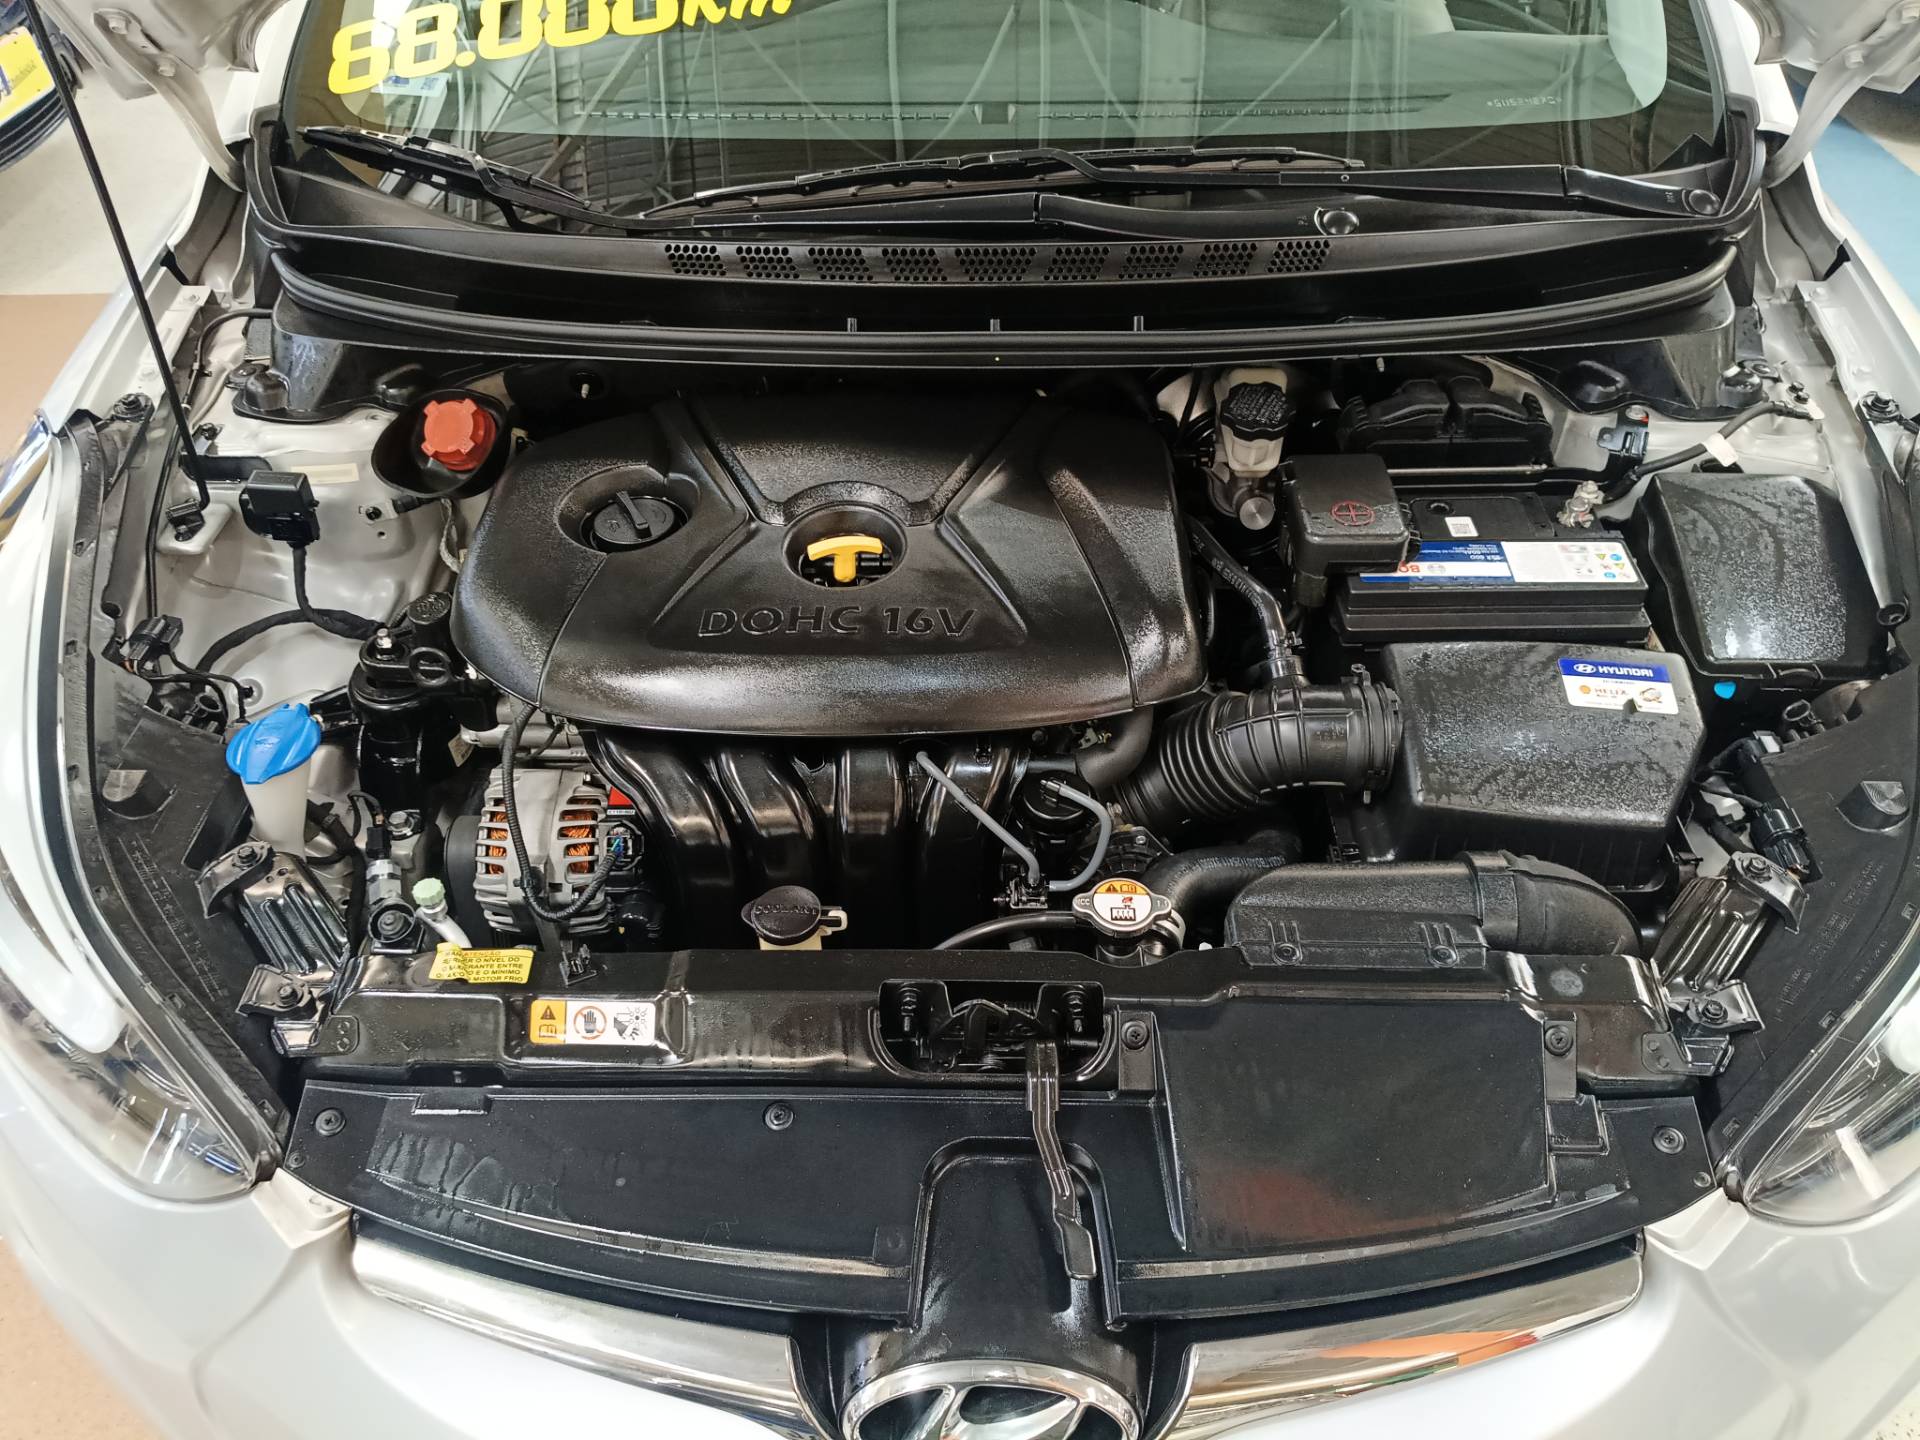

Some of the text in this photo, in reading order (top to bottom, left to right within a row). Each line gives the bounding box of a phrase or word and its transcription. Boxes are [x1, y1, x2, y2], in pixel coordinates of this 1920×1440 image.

[698, 606, 977, 637] DOHC 16V
[1598, 665, 1654, 677] HYUNDAI
[754, 904, 817, 914] COOLANT
